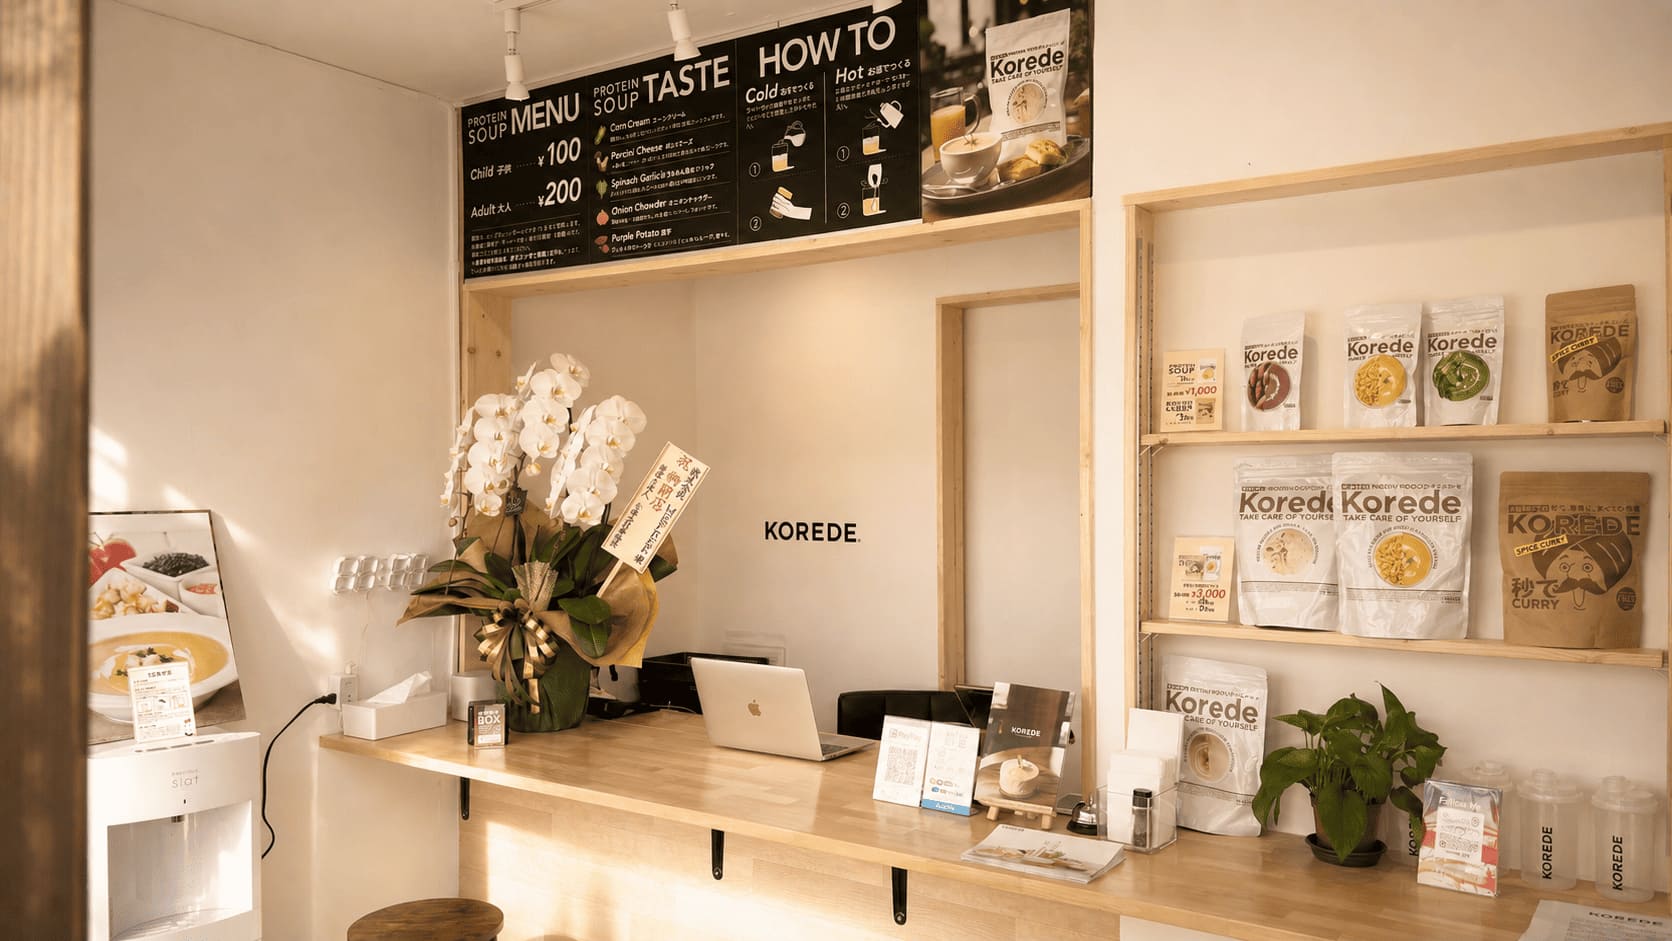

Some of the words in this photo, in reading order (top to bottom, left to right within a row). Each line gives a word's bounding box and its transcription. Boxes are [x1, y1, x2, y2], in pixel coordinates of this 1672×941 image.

[759, 27, 841, 78] HOW
[847, 15, 896, 56] TO
[990, 47, 1065, 78] Korede
[642, 55, 730, 104] TASTE
[835, 65, 865, 85] Hot
[593, 78, 639, 98] PROTEIN
[745, 82, 779, 104] Cold
[511, 92, 580, 135] MENU
[593, 91, 639, 117] SOUP
[467, 110, 508, 128] PROTEIN
[627, 117, 651, 129] Cream
[468, 122, 508, 145] SOUP
[470, 164, 494, 181] Child
[470, 203, 497, 219] Adult
[611, 204, 633, 216] Onion
[635, 229, 660, 240] Potato
[1347, 338, 1414, 357] Korede
[1427, 333, 1497, 353] Korede
[1244, 345, 1299, 364] Korede
[1341, 489, 1462, 514] Korede
[1239, 513, 1260, 521] TAKE
[1261, 513, 1283, 521] CARE
[1300, 513, 1334, 521] YOURSE
[1369, 514, 1393, 522] CARE
[1412, 515, 1462, 523] YOURSELF
[1507, 514, 1641, 536] KOREDE
[1511, 577, 1560, 598] 秒で
[1511, 598, 1560, 610] CURRY
[1166, 690, 1258, 723] Korede
[478, 714, 501, 725] BOX
[1184, 715, 1205, 724] CARE
[1542, 826, 1553, 880] KOREDE
[1612, 835, 1623, 891] KOREDE
